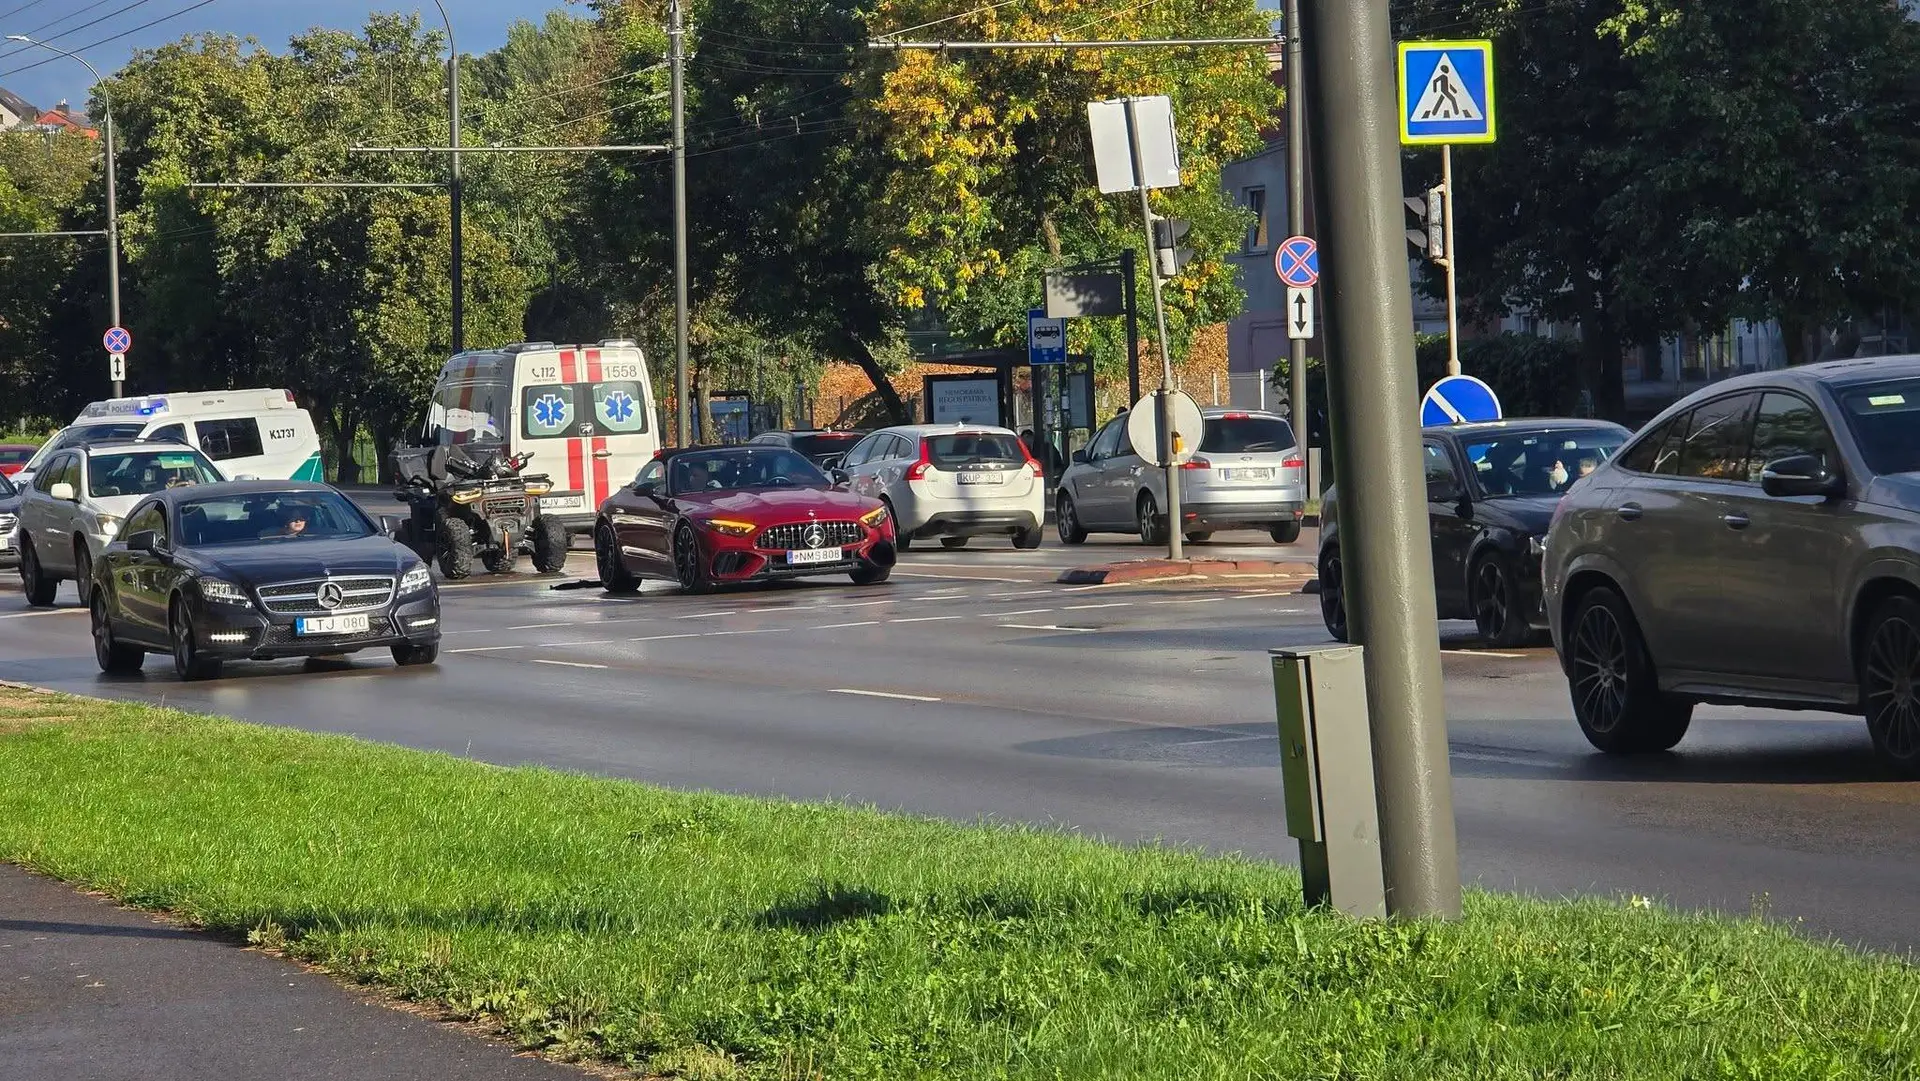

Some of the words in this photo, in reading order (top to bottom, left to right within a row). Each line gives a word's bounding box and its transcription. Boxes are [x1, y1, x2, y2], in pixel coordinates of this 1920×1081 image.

[540, 366, 556, 378] 112
[604, 365, 637, 378] 1558
[269, 427, 295, 440] K1737
[306, 618, 335, 631] LTJ
[343, 616, 366, 629] 080
